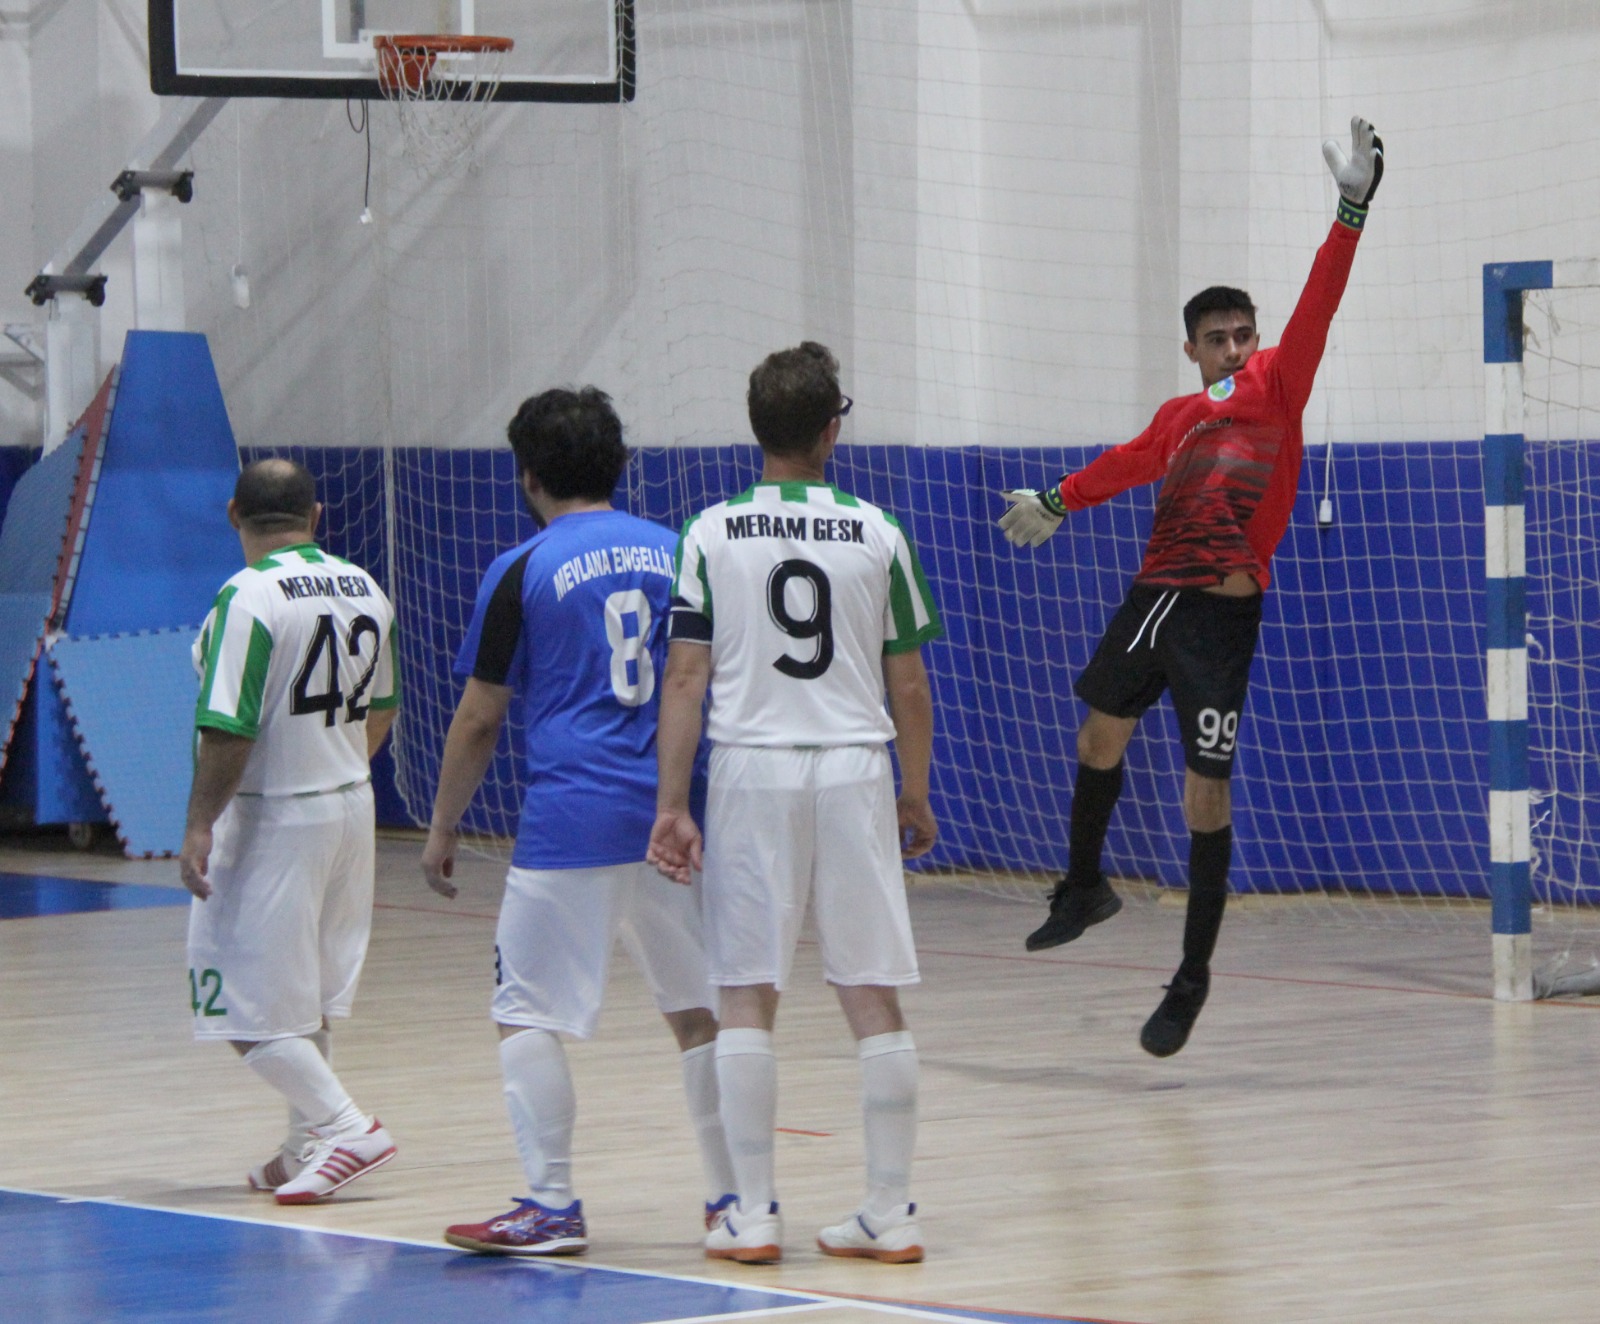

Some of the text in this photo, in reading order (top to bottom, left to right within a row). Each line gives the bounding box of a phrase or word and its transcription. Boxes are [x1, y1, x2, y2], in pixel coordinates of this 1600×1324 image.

[725, 514, 865, 544] MERAM GESK
[278, 575, 340, 601] MERAM
[553, 545, 677, 602] MEVLANA ENGELLİL
[604, 588, 655, 707] 8
[766, 558, 834, 680] 9
[290, 614, 380, 728] 42
[1196, 707, 1238, 752] 99
